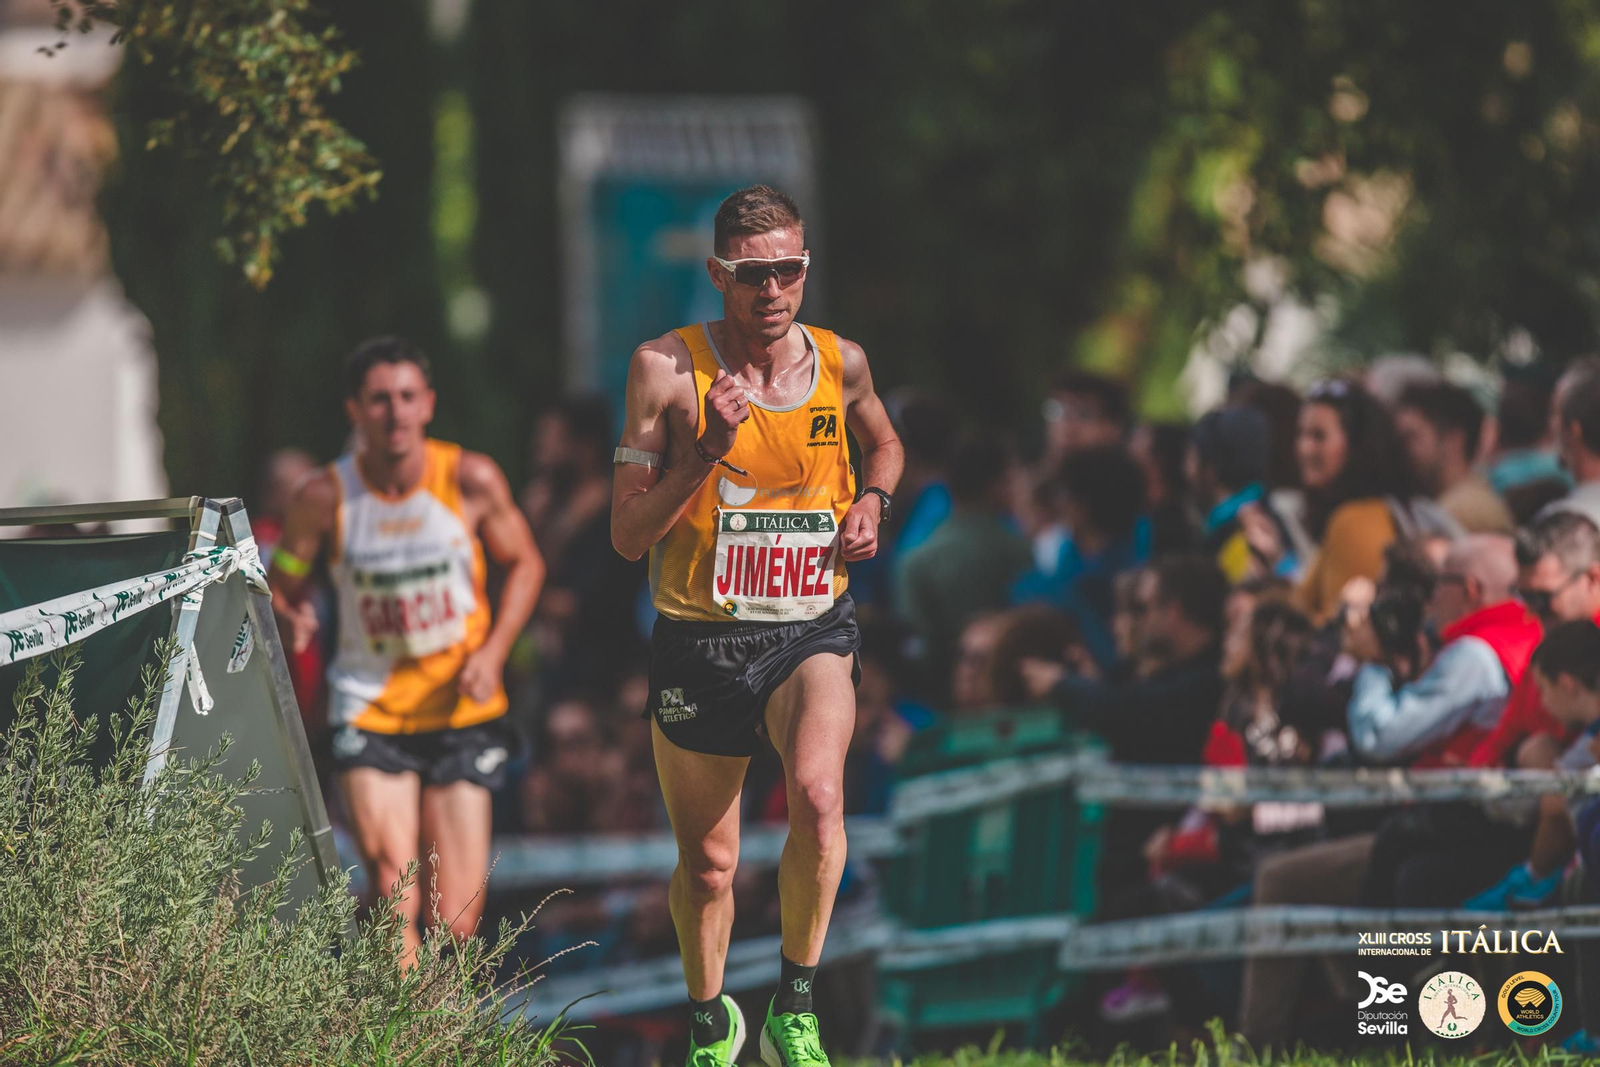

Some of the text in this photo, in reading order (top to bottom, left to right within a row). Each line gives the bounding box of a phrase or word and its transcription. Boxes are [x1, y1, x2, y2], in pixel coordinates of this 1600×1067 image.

[810, 414, 837, 439] PA
[755, 514, 810, 529] ITÁLICA
[717, 534, 834, 597] JIMÉNEZ
[78, 608, 95, 631] Sevilla
[24, 628, 44, 650] Sevilla
[660, 687, 684, 706] PA
[658, 703, 698, 715] PAMPLONA
